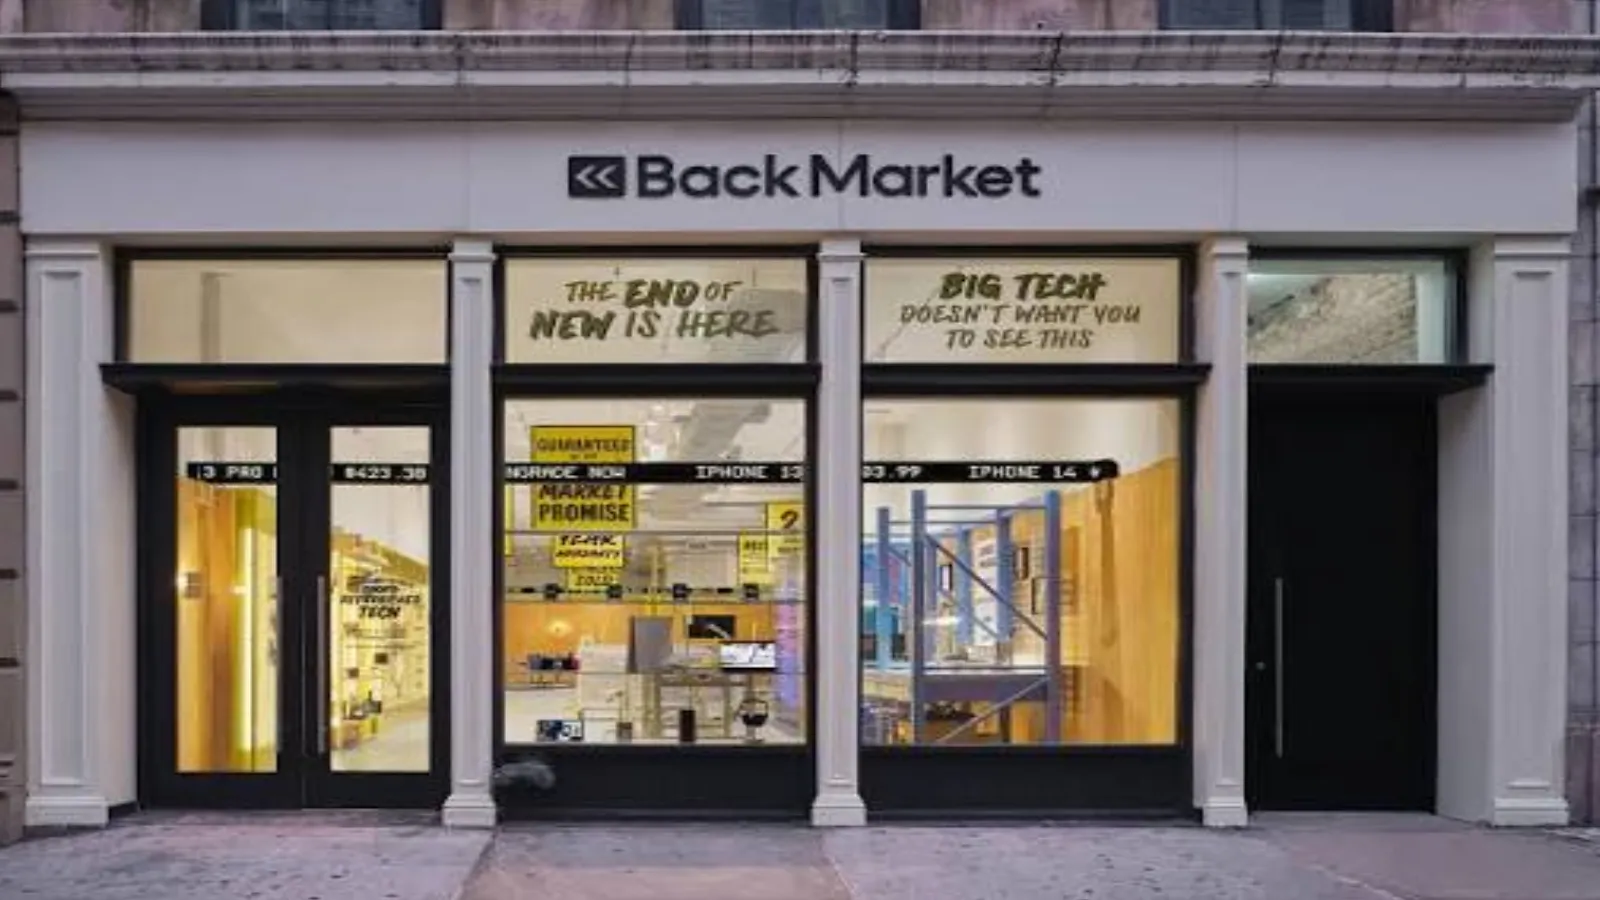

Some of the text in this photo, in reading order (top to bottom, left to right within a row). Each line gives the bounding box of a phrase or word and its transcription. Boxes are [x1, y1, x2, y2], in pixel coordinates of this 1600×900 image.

[637, 154, 1041, 198] Back Market
[564, 279, 743, 308] THE END OF
[939, 272, 1106, 301] BIG TECH
[529, 309, 779, 340] NEW IS HERE
[900, 304, 1141, 325] DOESN'T WANT YOU
[945, 329, 1094, 349] TO SEE THIS
[694, 465, 769, 479] IPHONE
[968, 465, 1041, 479] IPHONE
[1052, 465, 1077, 479] 14
[538, 484, 627, 501] MARKET
[538, 503, 630, 523] PROMISE
